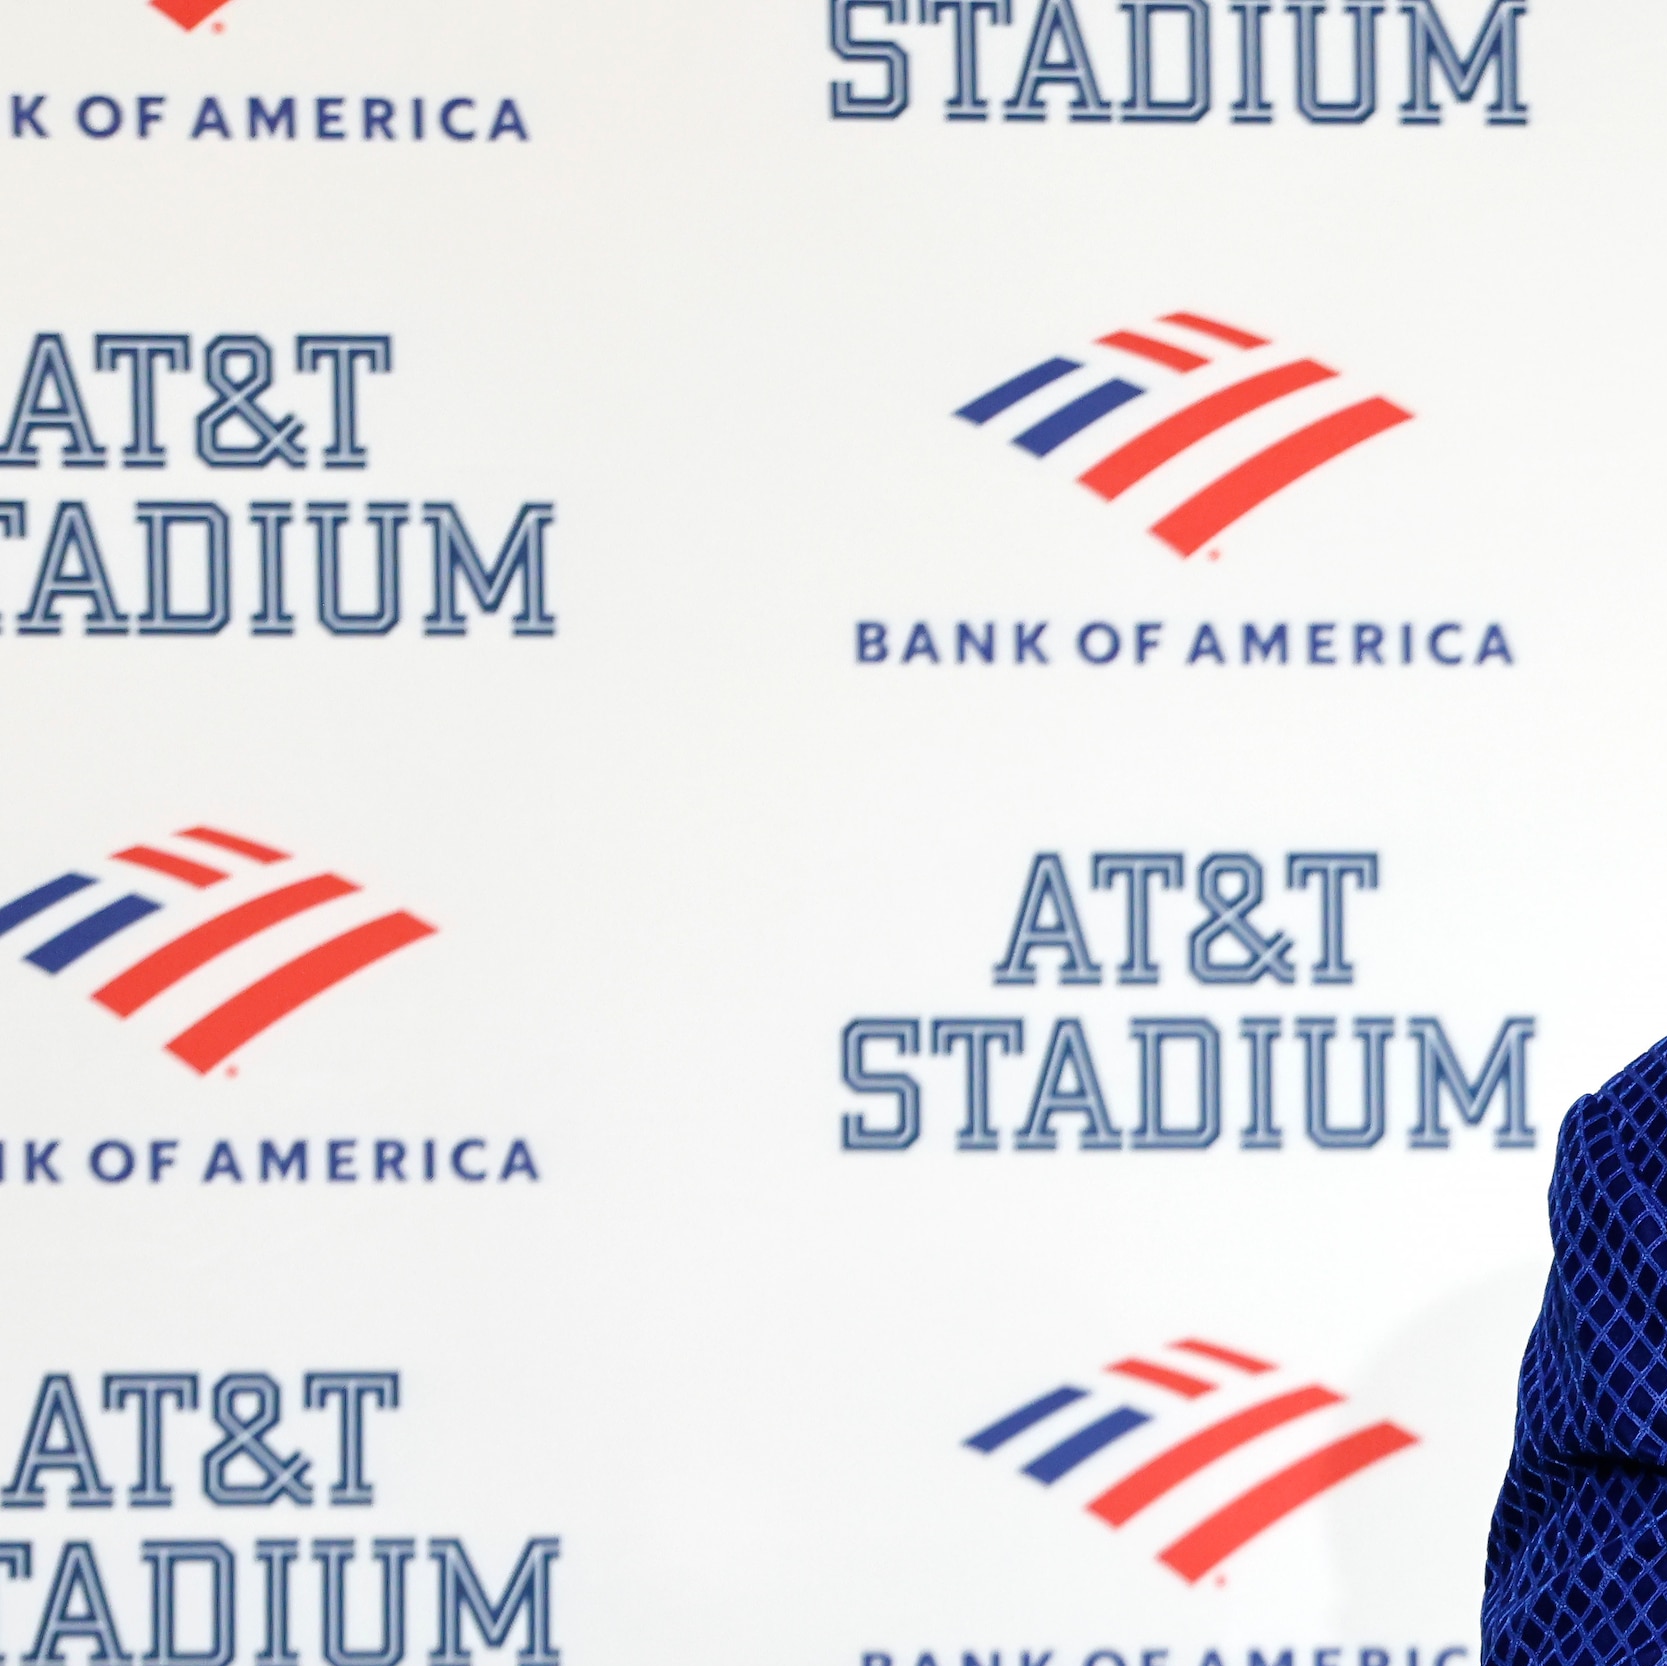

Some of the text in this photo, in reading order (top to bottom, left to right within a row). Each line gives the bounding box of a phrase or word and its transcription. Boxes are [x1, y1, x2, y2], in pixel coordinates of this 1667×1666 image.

[76, 95, 165, 139] OF
[191, 97, 527, 141] AMERICA
[829, 0, 1528, 126] STADIUM
[0, 333, 392, 469] AT&T
[0, 500, 555, 637] ADIUM
[856, 621, 1513, 665] BANK OF AMERICA
[993, 851, 1379, 986] AT&T
[841, 1016, 1536, 1151] STADIUM
[89, 1140, 178, 1183] OF
[203, 1138, 538, 1182] AMERICA
[0, 1371, 400, 1509] AT&T
